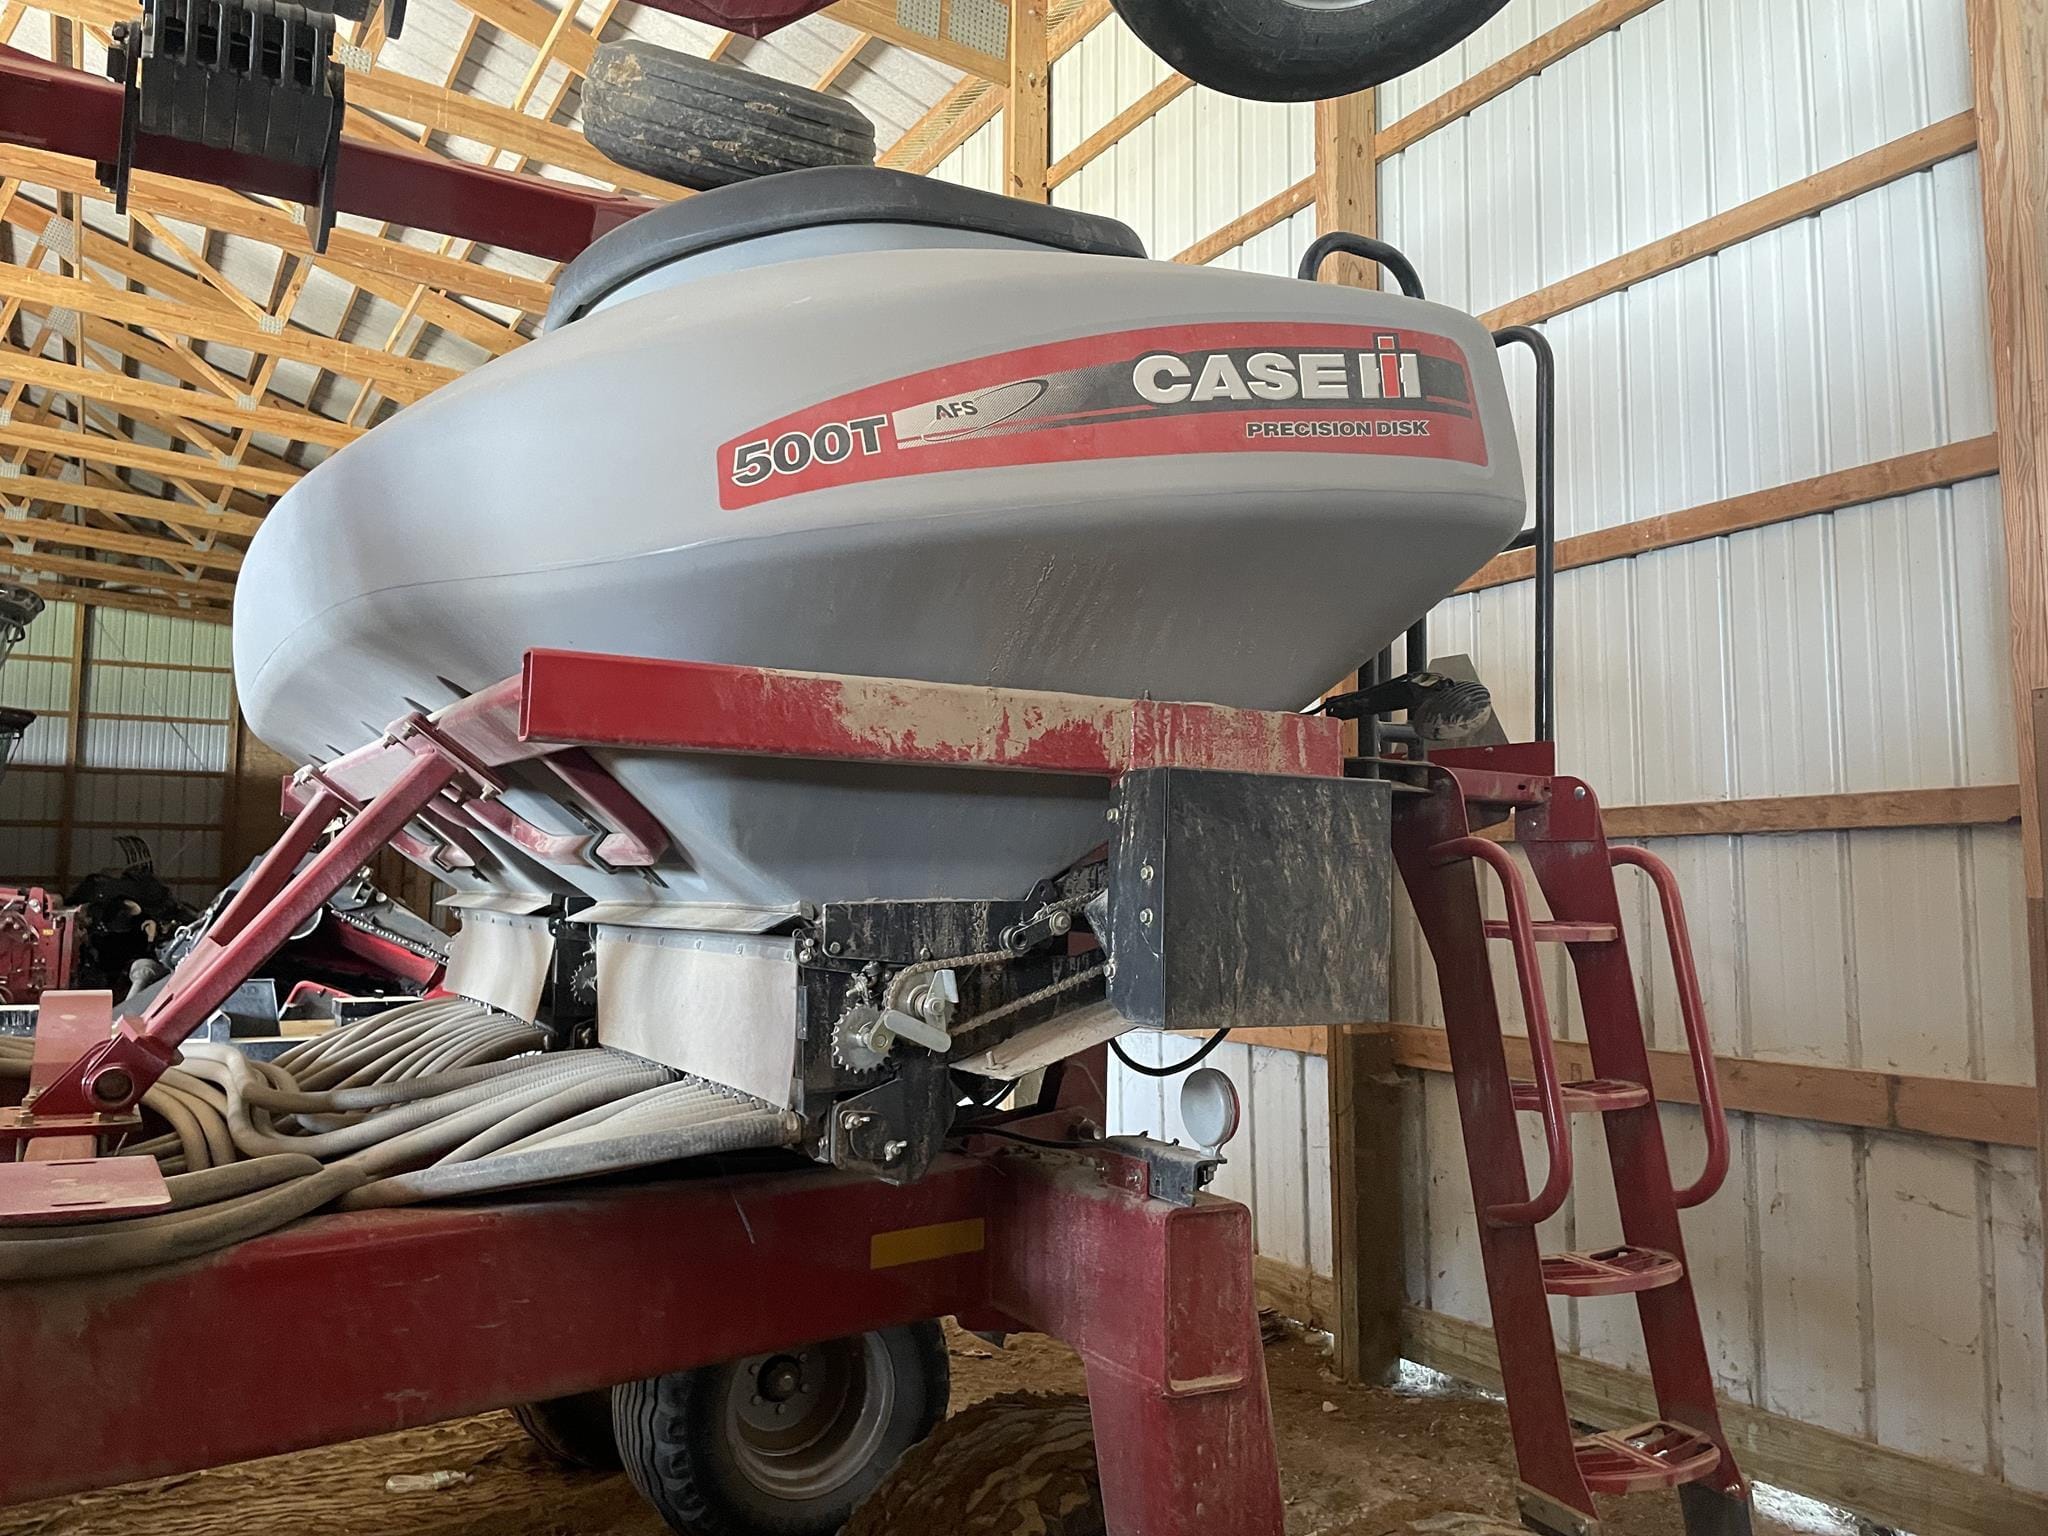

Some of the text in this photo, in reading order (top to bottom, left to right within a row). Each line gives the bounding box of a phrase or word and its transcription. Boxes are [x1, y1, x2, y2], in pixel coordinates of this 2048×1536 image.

[1133, 351, 1348, 403] CASE
[935, 399, 979, 420] AFS
[1246, 420, 1430, 438] PRECISION DISK
[731, 415, 887, 487] 500T
